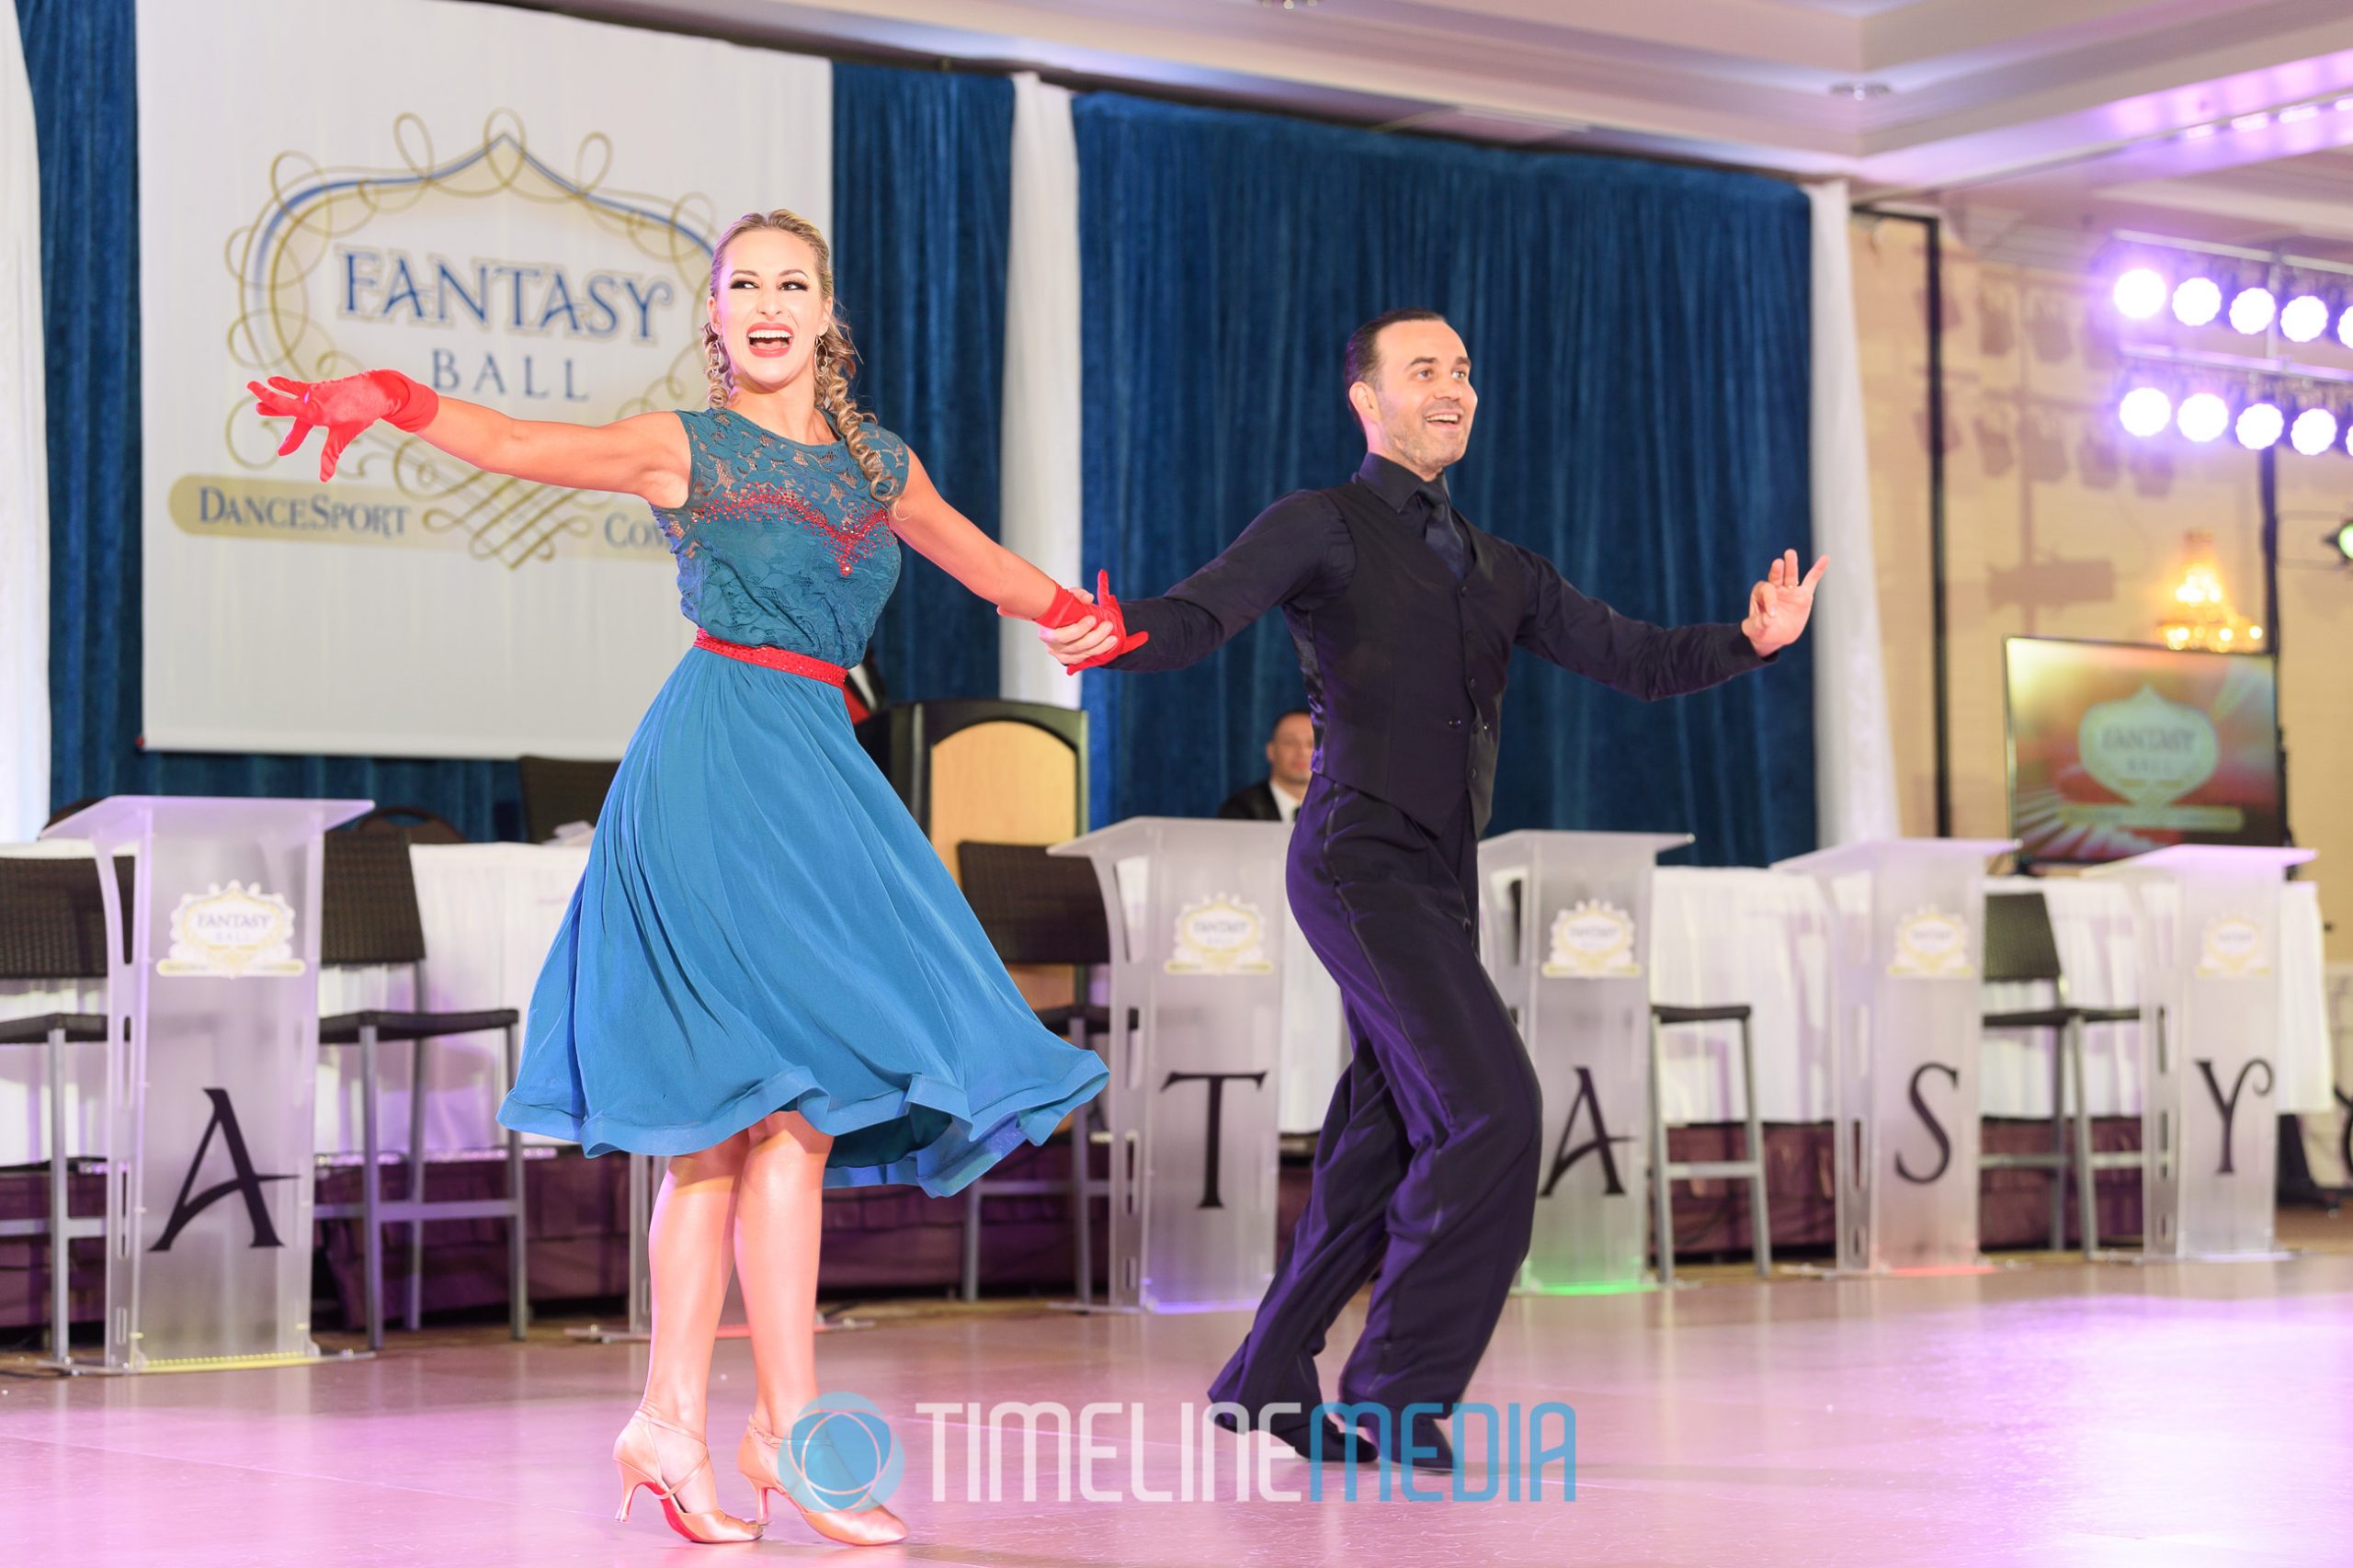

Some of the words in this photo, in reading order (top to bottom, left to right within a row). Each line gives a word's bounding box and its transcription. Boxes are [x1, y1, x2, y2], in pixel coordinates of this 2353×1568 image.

[339, 248, 675, 341] FANTASY
[430, 347, 589, 402] BALL
[197, 913, 271, 928] FANTASY
[147, 1087, 301, 1253] A
[1160, 1071, 1268, 1209] T
[1539, 1067, 1636, 1197] A
[1894, 1062, 1958, 1184] S
[2193, 1057, 2274, 1175] Y
